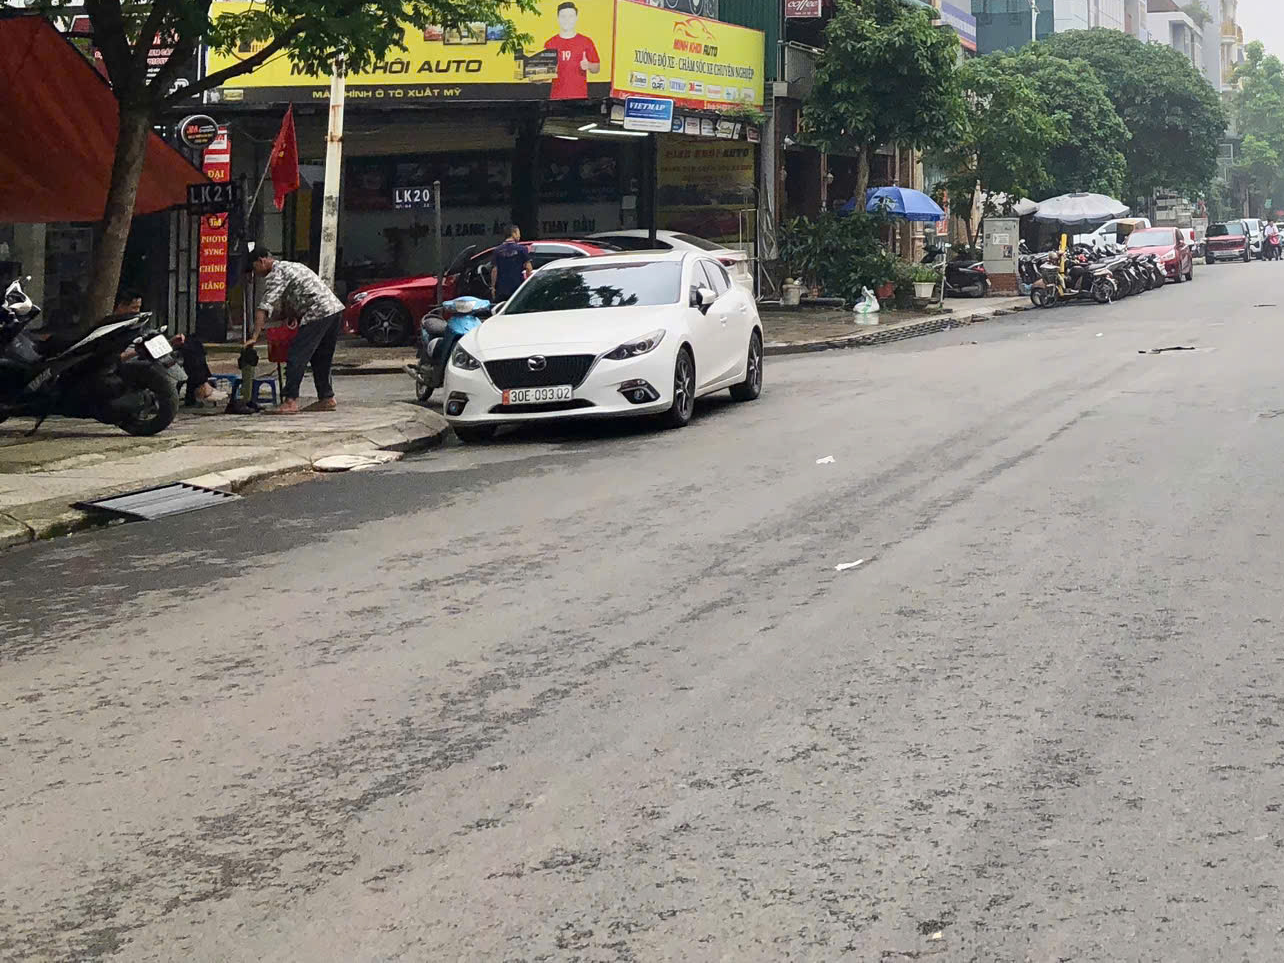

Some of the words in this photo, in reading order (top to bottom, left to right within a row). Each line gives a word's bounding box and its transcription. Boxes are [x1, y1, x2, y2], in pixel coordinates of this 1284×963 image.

[673, 39, 689, 51] MINH
[703, 45, 718, 57] AUTO
[561, 50, 571, 62] 19
[667, 55, 676, 68] XE
[417, 59, 483, 73] AUTO
[312, 89, 331, 98] MÀ
[344, 89, 372, 98] HÌNH
[376, 88, 384, 97] Ô
[388, 88, 403, 97] TÔ
[408, 87, 440, 97] XUẤT
[444, 87, 462, 97] MỸ
[629, 102, 666, 111] VIETMAP
[190, 184, 232, 203] LK21
[396, 189, 430, 203] LK20
[201, 235, 227, 244] PHOTO
[203, 248, 225, 256] SYNC
[200, 263, 227, 273] CHÍNH
